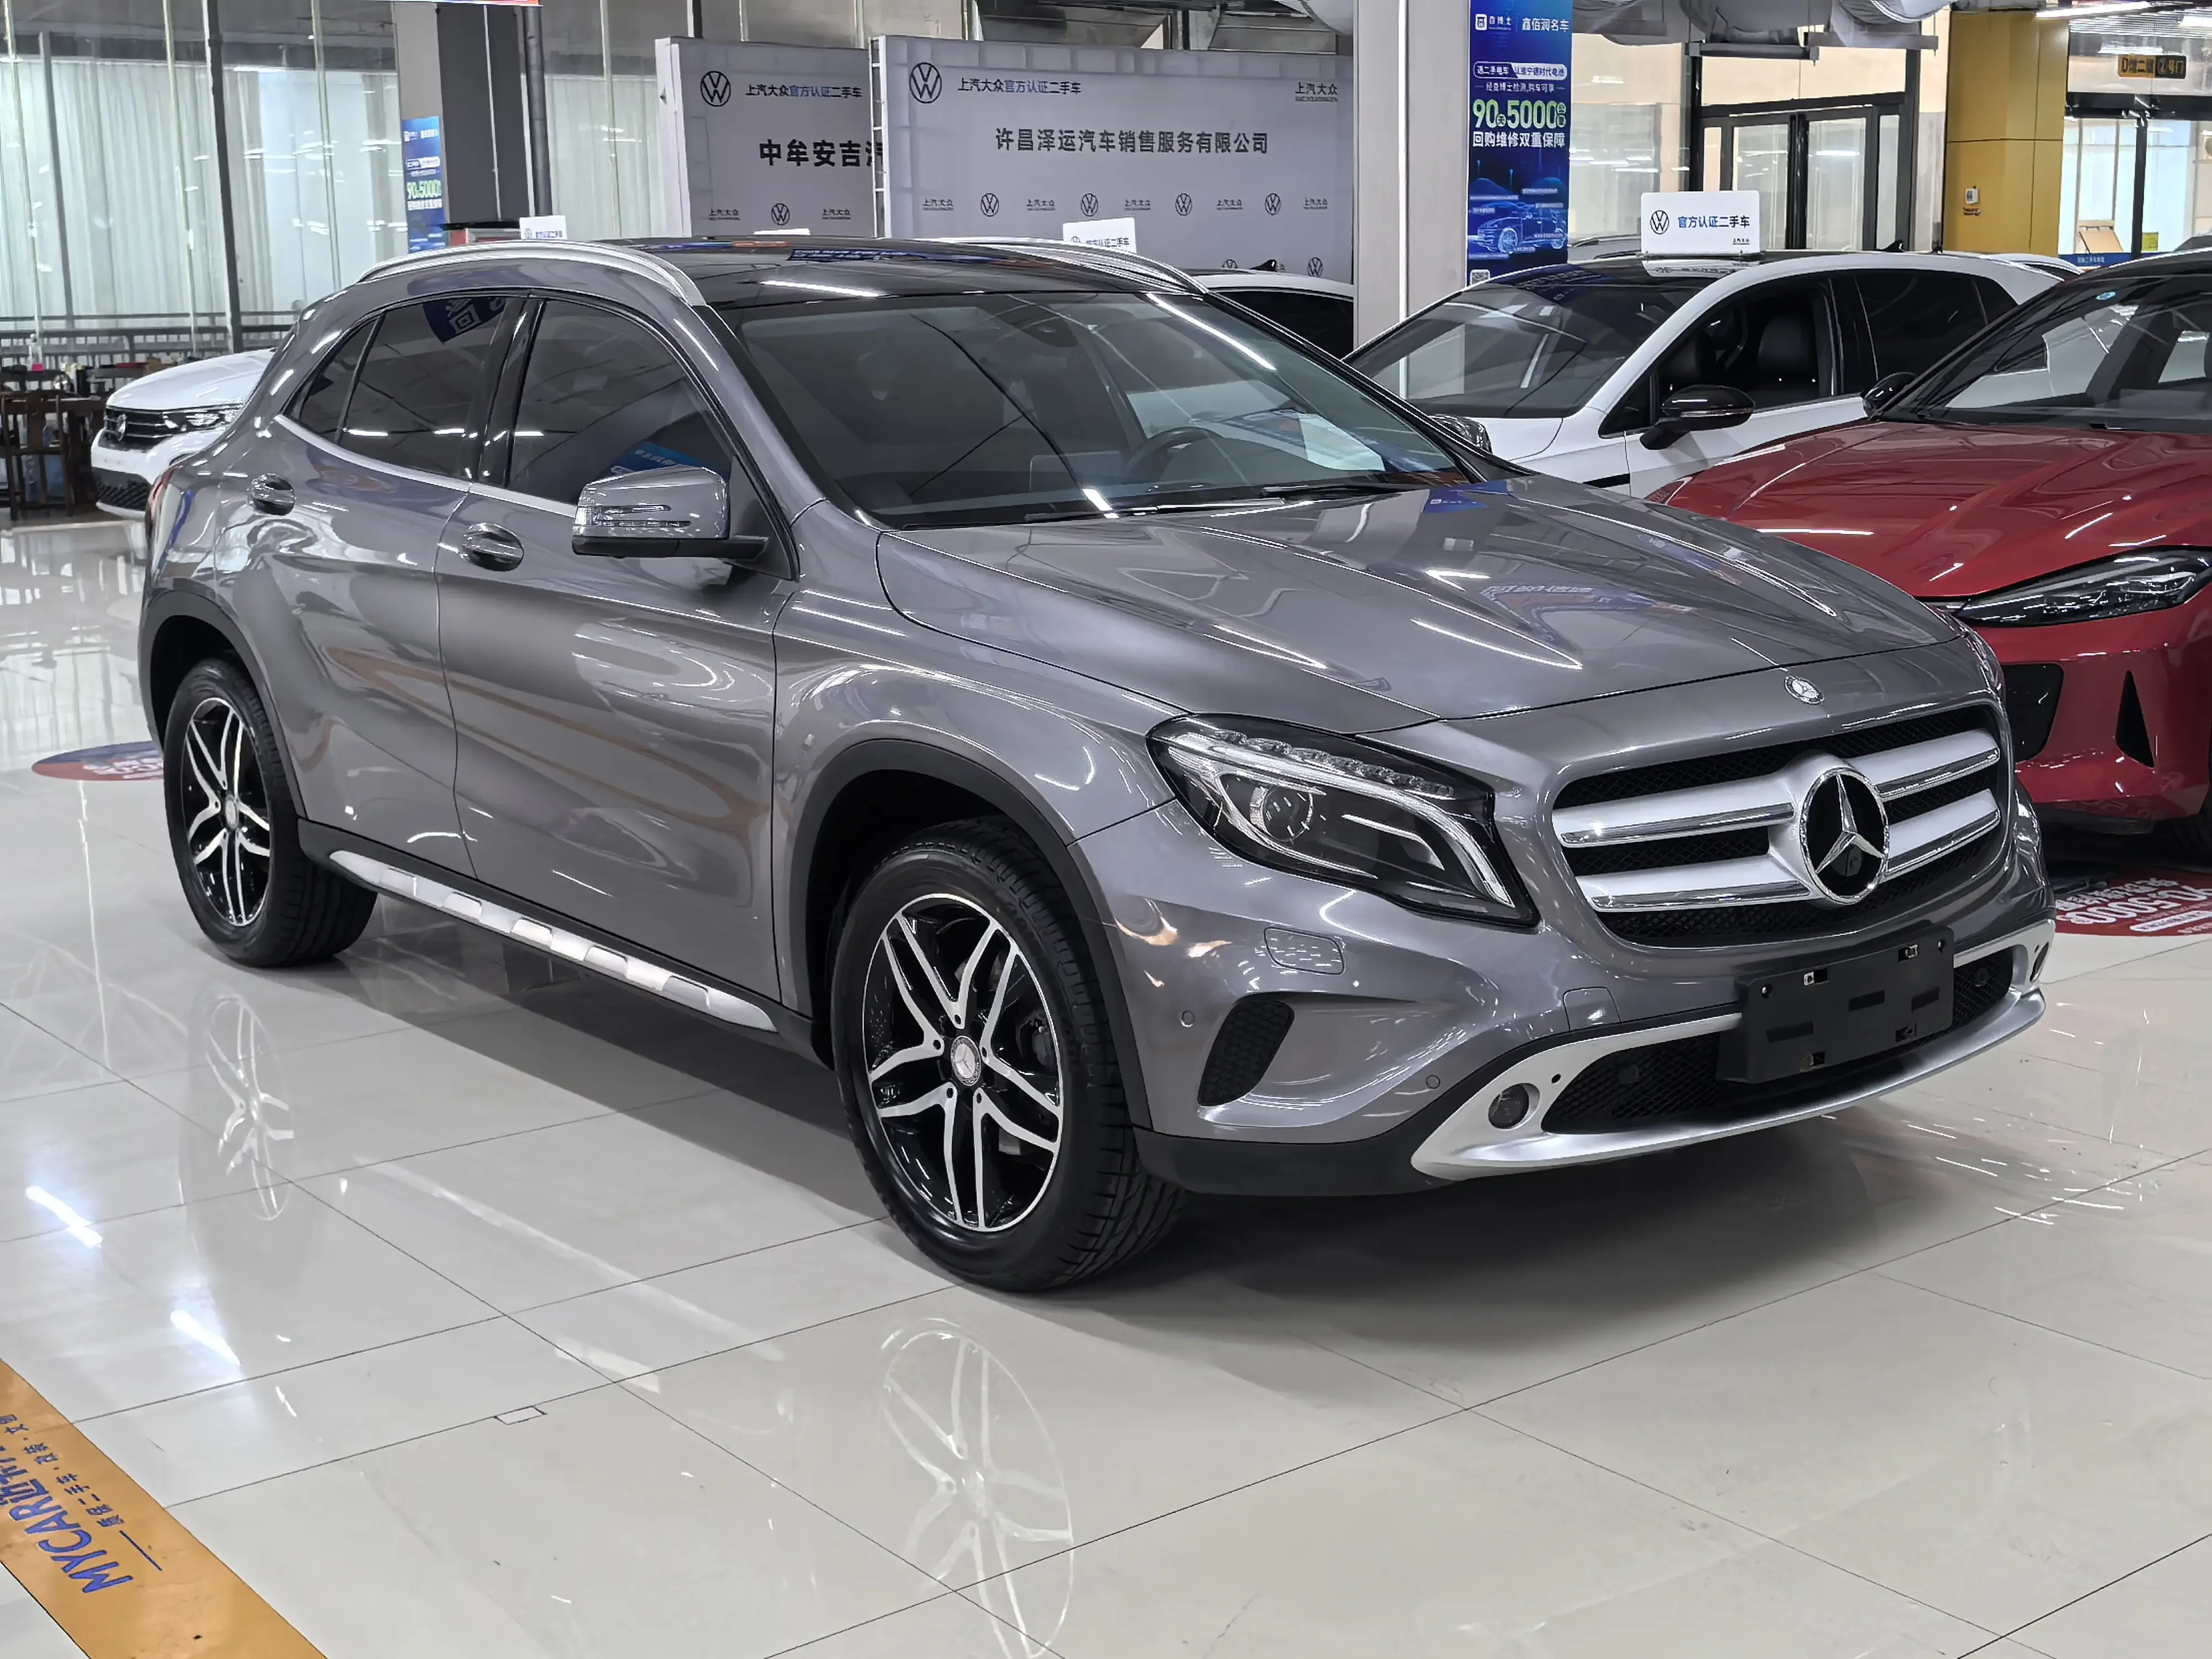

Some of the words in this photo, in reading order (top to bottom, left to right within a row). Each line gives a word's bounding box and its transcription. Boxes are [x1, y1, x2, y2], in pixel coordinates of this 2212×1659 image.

[746, 84, 862, 98] 上汽大众官方认证二手车
[958, 77, 1082, 95] 上汽大众官方认证二手车
[1295, 82, 1338, 95] 上汽大众
[996, 128, 1267, 154] 许昌泽运汽车销售服务有限公司
[1472, 131, 1566, 148] 回购维修双重保障
[1678, 215, 1750, 228] 官方认证二手车
